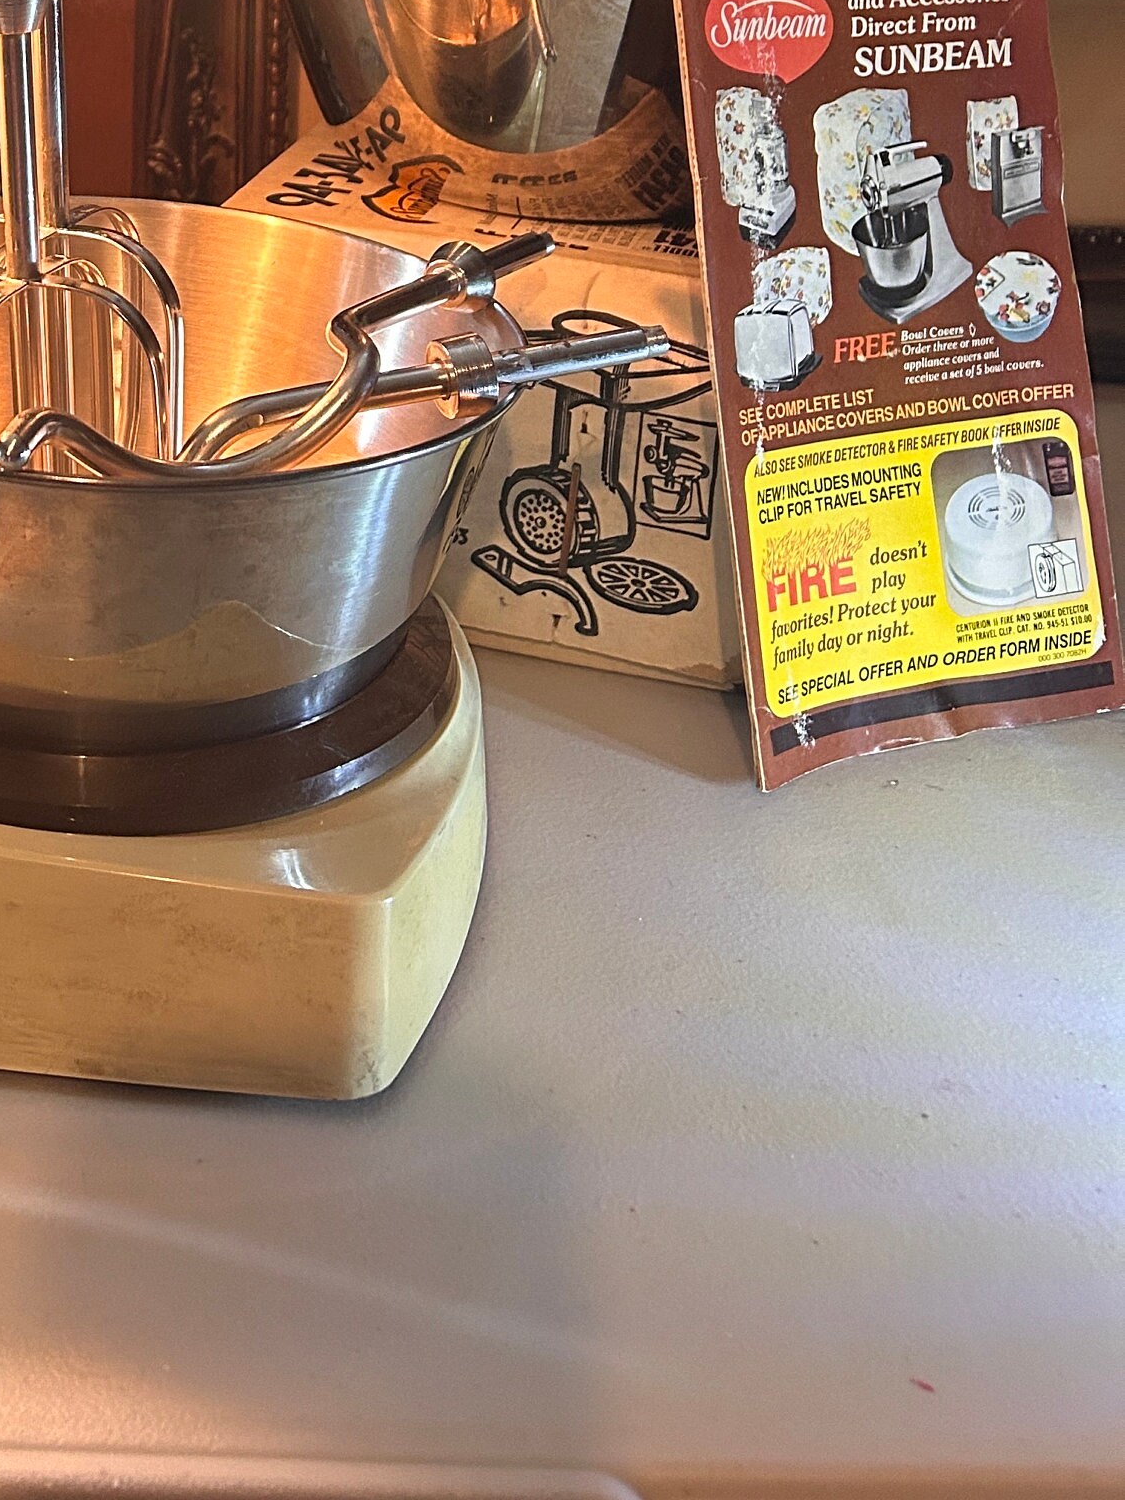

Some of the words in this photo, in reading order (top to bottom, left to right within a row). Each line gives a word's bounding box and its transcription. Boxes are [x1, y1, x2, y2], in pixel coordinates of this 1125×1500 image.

[850, 14, 915, 38] Direct
[922, 11, 976, 33] From
[854, 37, 1013, 78] SUNBEAM
[833, 331, 897, 364] FREE
[900, 328, 927, 342] Bowl
[929, 325, 965, 338] Covers
[902, 344, 931, 356] Order
[932, 342, 958, 353] three
[960, 339, 970, 349] or
[972, 336, 995, 347] more
[903, 356, 950, 372] appliance
[951, 353, 982, 365] covers
[983, 347, 1000, 360] and
[904, 371, 939, 385] receive
[949, 368, 964, 379] set
[965, 365, 976, 379] of
[976, 364, 982, 375] 5
[984, 361, 1004, 374] bowl
[1006, 359, 1044, 372] covers.
[738, 407, 763, 426] SEE
[766, 393, 841, 421] COMPLETE
[843, 389, 874, 407] LIST
[741, 428, 759, 447] OF
[760, 416, 835, 443] APPLIANCE
[836, 406, 894, 429] COVERS
[895, 401, 925, 420] AND
[927, 396, 971, 416] BOWL
[972, 389, 1019, 409] COVER
[1021, 383, 1075, 403] OFFER
[754, 460, 777, 478] ALSO
[779, 456, 796, 473] SEE
[797, 450, 832, 469] SMOKE
[834, 443, 886, 463] DETECTOR
[888, 440, 896, 454] &
[897, 437, 919, 452] FIRE
[920, 430, 959, 449] SAFETY
[961, 426, 989, 443] BOOK
[1023, 417, 1061, 434] INSIDE
[757, 484, 785, 506] NEW!
[786, 474, 849, 499] INCLUDES
[851, 462, 922, 487] MOUNTING
[758, 505, 785, 525] CLIP
[787, 500, 812, 518] FOR
[815, 490, 867, 512] TRAVEL
[869, 481, 921, 503] SAFETY
[869, 540, 928, 565] doesn't
[766, 554, 857, 612] FIRE
[871, 571, 906, 594] play
[771, 606, 834, 644] favorites!
[837, 596, 897, 623] Protect
[901, 594, 937, 615] your
[955, 619, 991, 633] CENTURION
[1000, 615, 1015, 625] FIRE
[1016, 612, 1031, 622] AND
[1033, 608, 1056, 621] SMOKE
[1057, 603, 1089, 617] DETECTOR
[773, 638, 814, 671] family
[817, 633, 843, 653] day
[846, 631, 863, 646] or
[867, 619, 914, 643] night.
[956, 633, 973, 644] WITH
[975, 630, 997, 643] TRAVEL
[778, 683, 799, 705] SEE
[801, 669, 855, 698] SPECIAL
[858, 659, 904, 682] OFFER
[906, 653, 938, 673] AND
[942, 646, 996, 666] ORDER
[999, 637, 1040, 659] FORM
[1044, 630, 1092, 651] INSIDE
